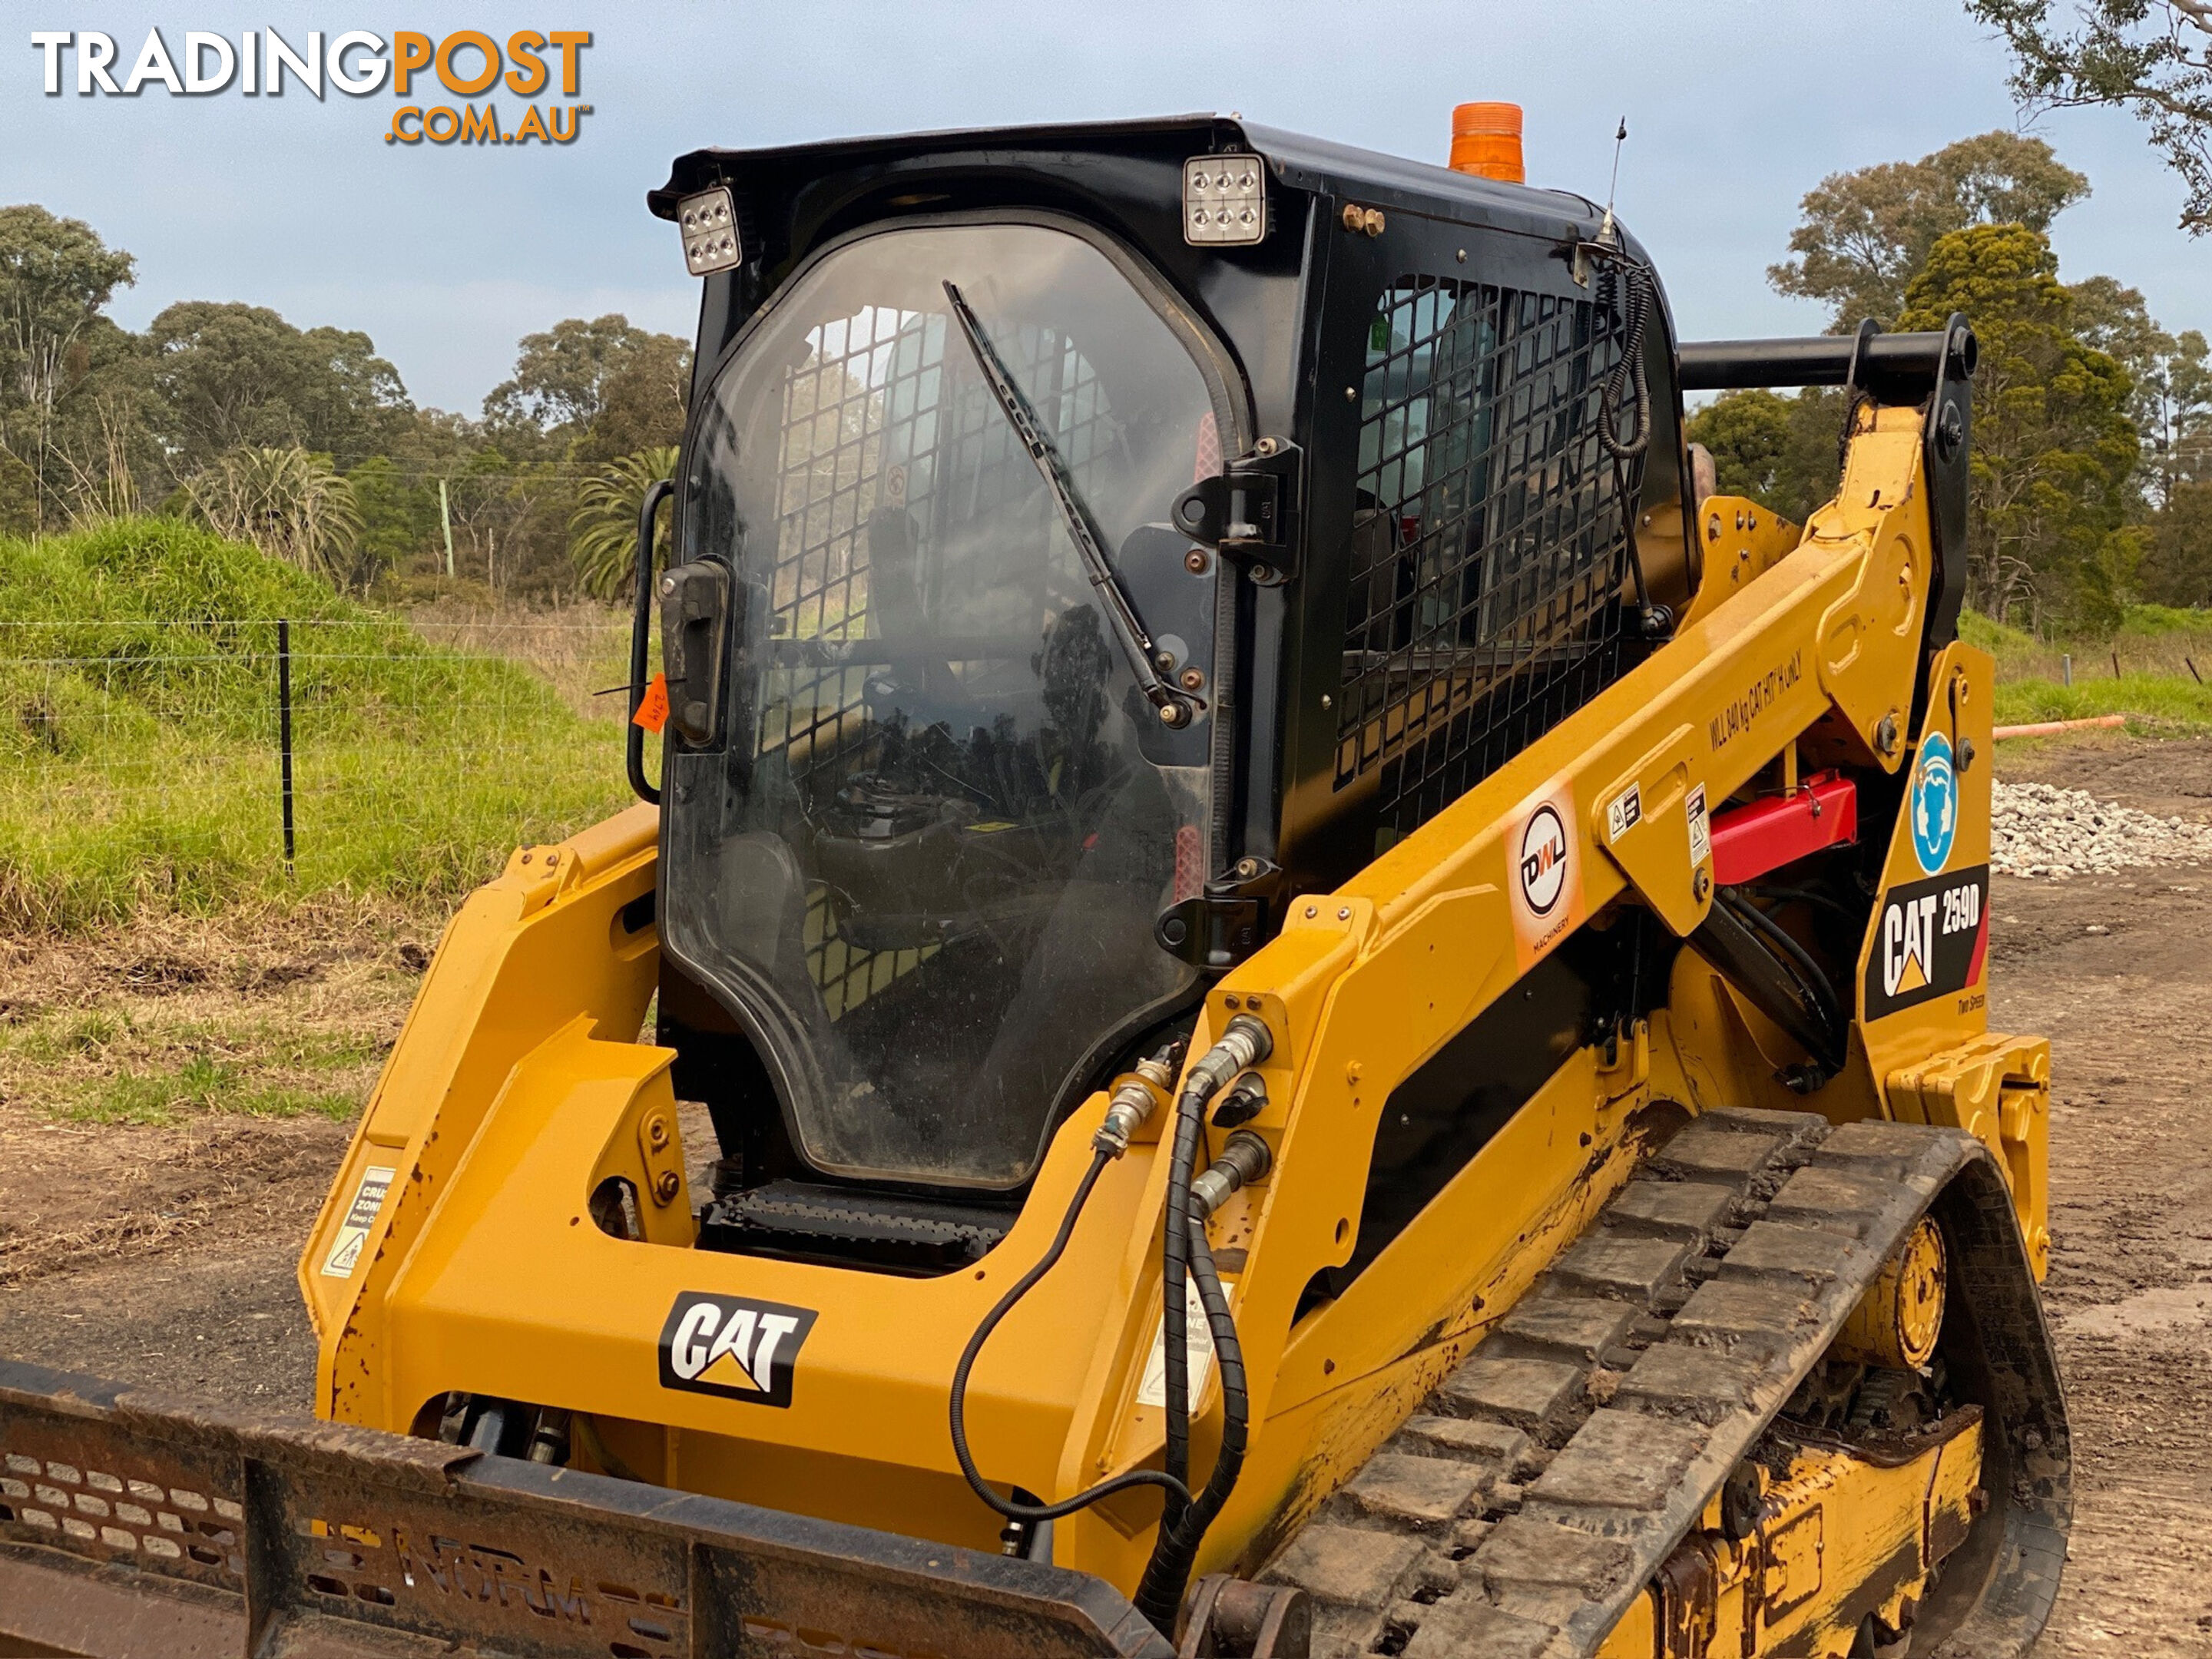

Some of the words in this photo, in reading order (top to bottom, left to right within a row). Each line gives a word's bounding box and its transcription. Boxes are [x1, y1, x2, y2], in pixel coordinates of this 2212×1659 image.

[1522, 835, 1566, 886] DWL
[1533, 915, 1570, 955] MACHINERY
[1884, 895, 1937, 997] CAT
[1942, 883, 1979, 935] 259D
[671, 1302, 799, 1392] CAT
